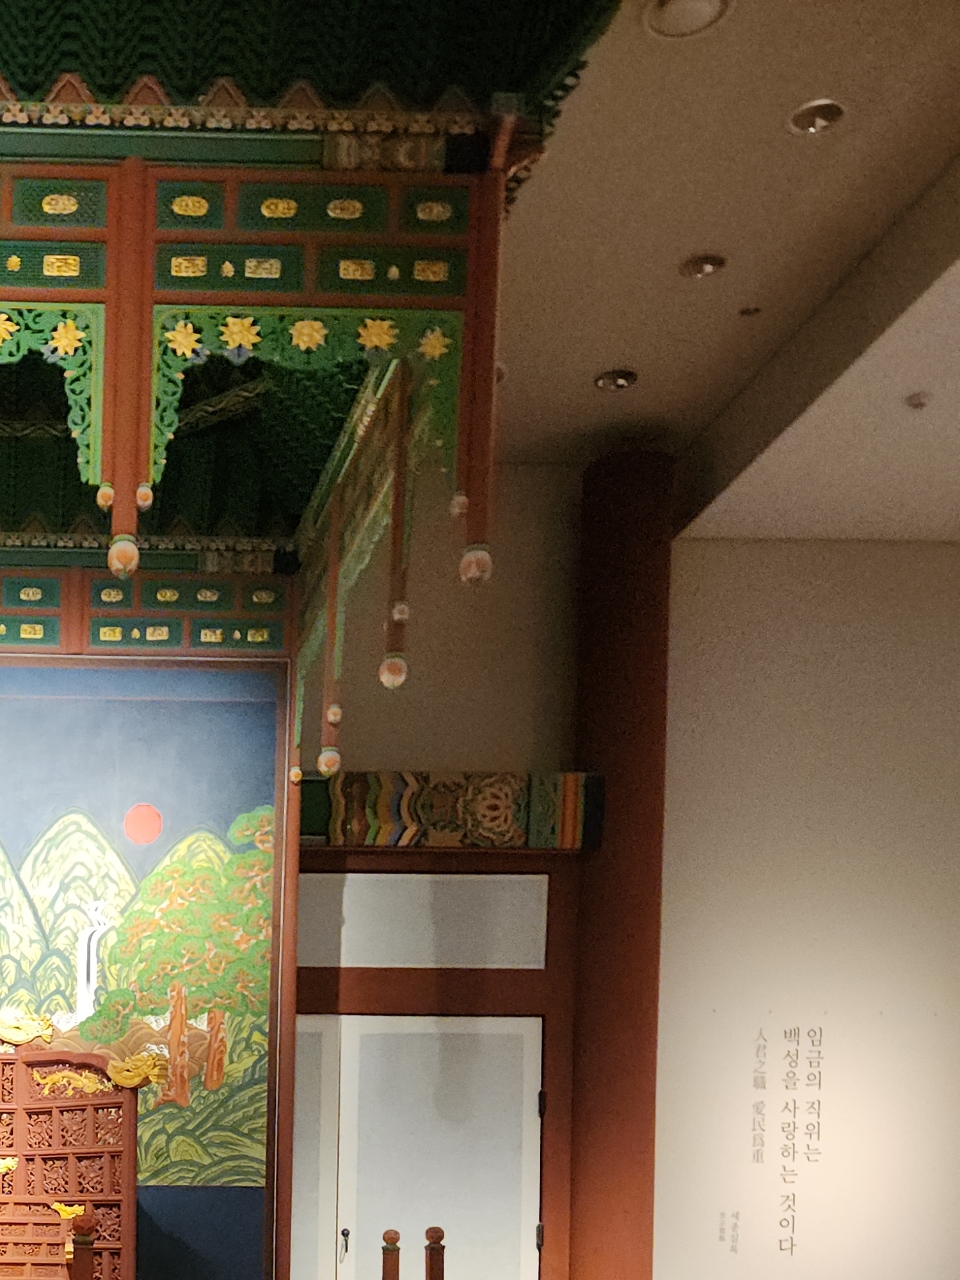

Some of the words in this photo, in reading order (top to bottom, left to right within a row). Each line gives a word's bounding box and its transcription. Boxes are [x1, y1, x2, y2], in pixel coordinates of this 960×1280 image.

[781, 1026, 800, 1091] 백성을
[805, 1026, 824, 1091] 임금의
[779, 1098, 800, 1184] 사랑하는
[803, 1099, 822, 1163] 직위는
[778, 1193, 797, 1256] 것이다
